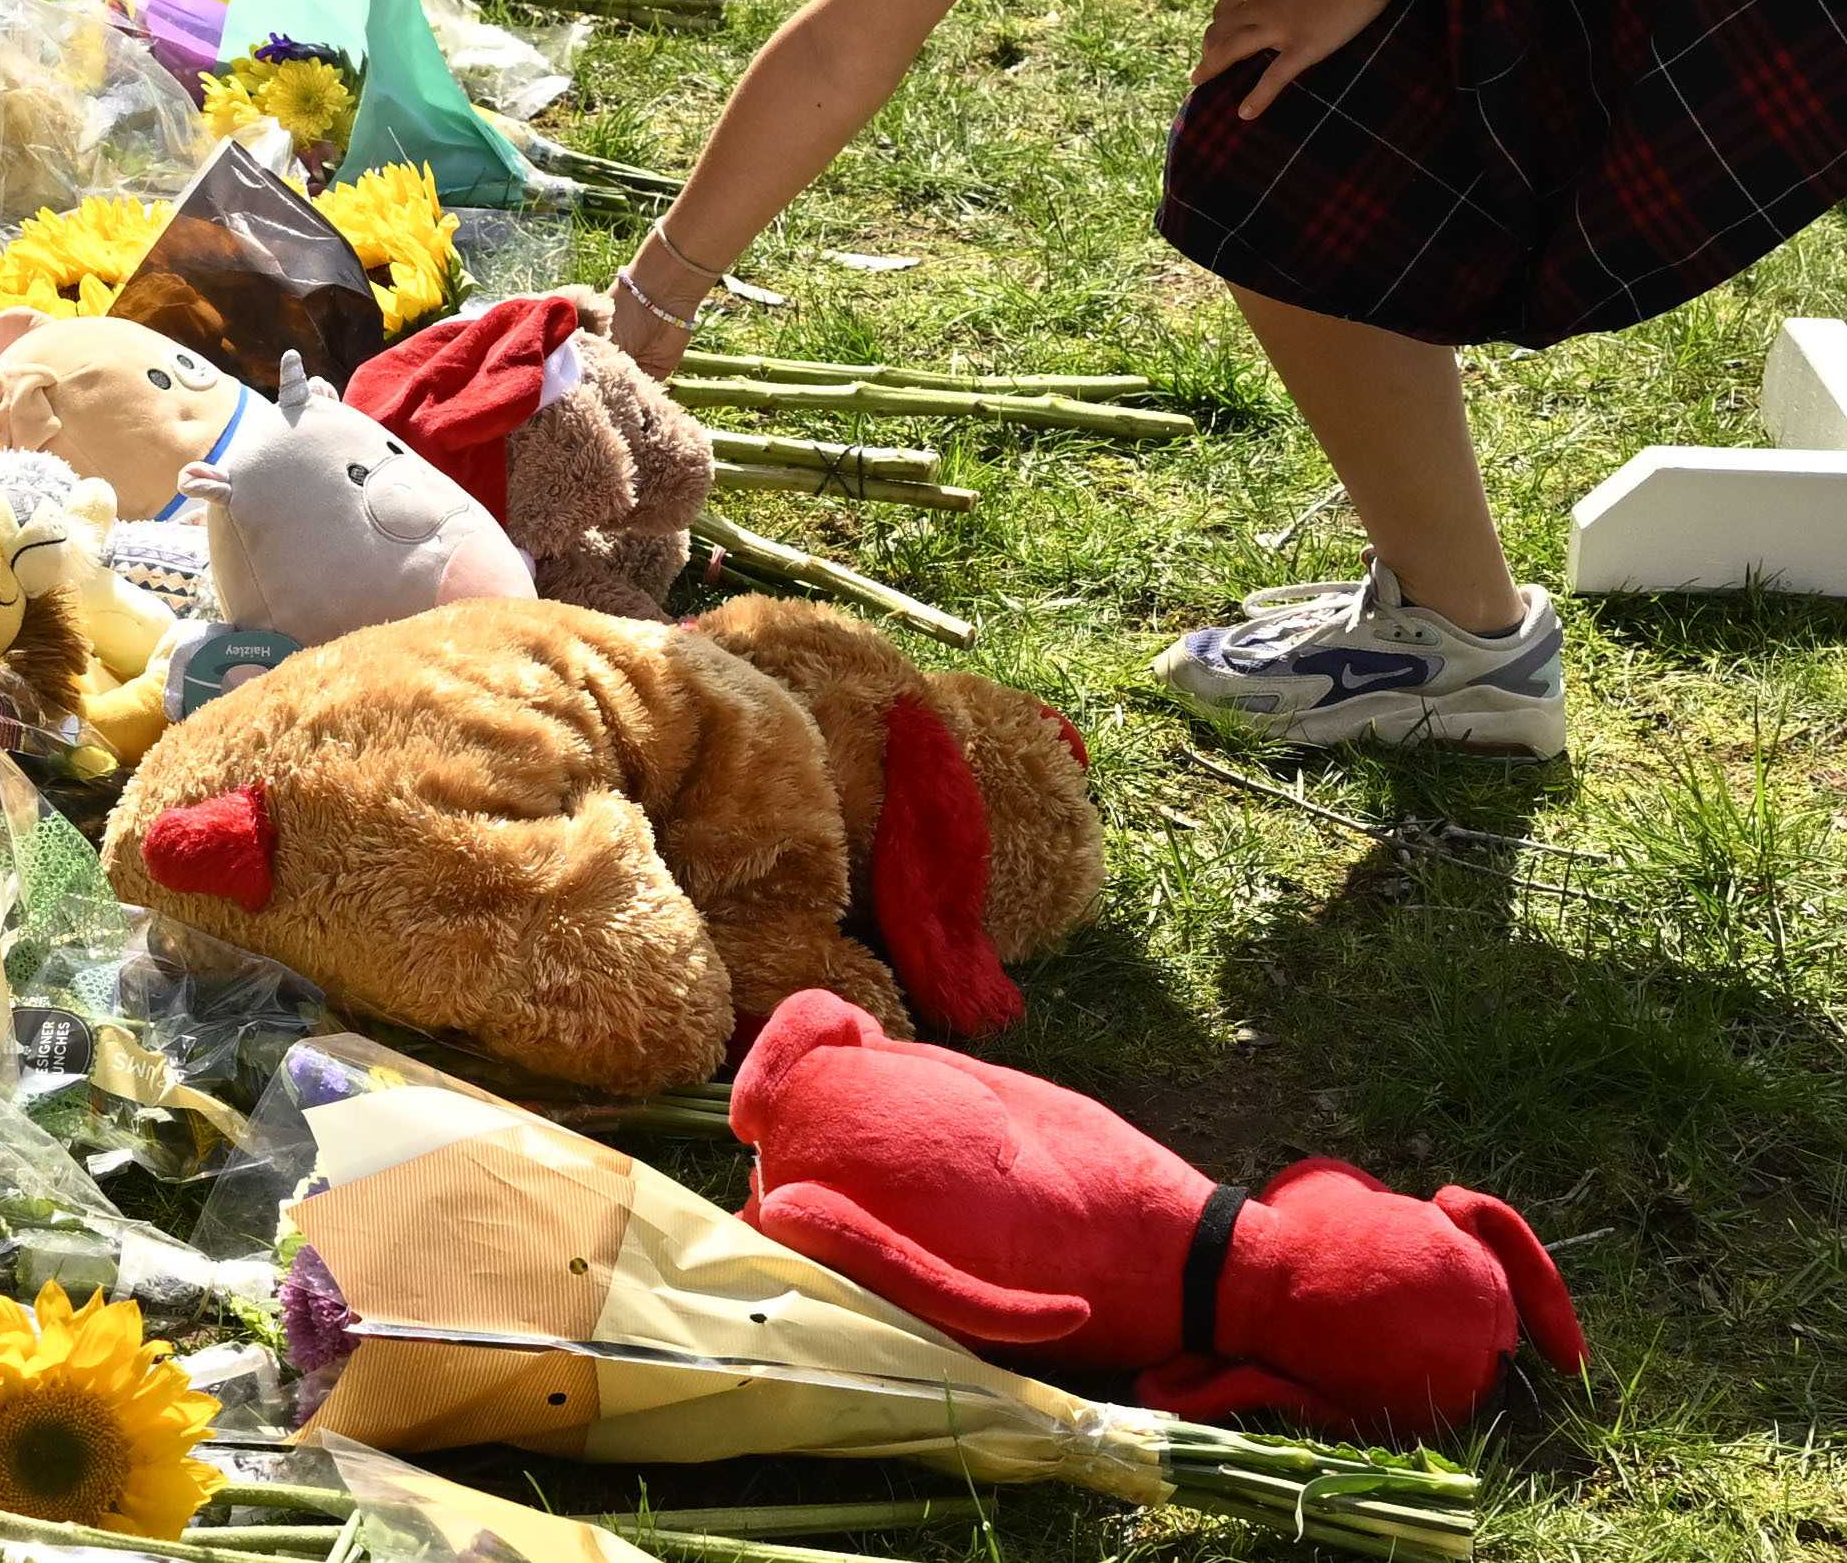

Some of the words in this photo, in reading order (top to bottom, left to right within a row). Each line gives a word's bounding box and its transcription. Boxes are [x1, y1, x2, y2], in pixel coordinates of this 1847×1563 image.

[225, 644, 271, 658] Haizley
[35, 1021, 56, 1075] ESIGNER
[53, 1021, 71, 1075] UNCHES
[113, 1051, 166, 1089] UMS
